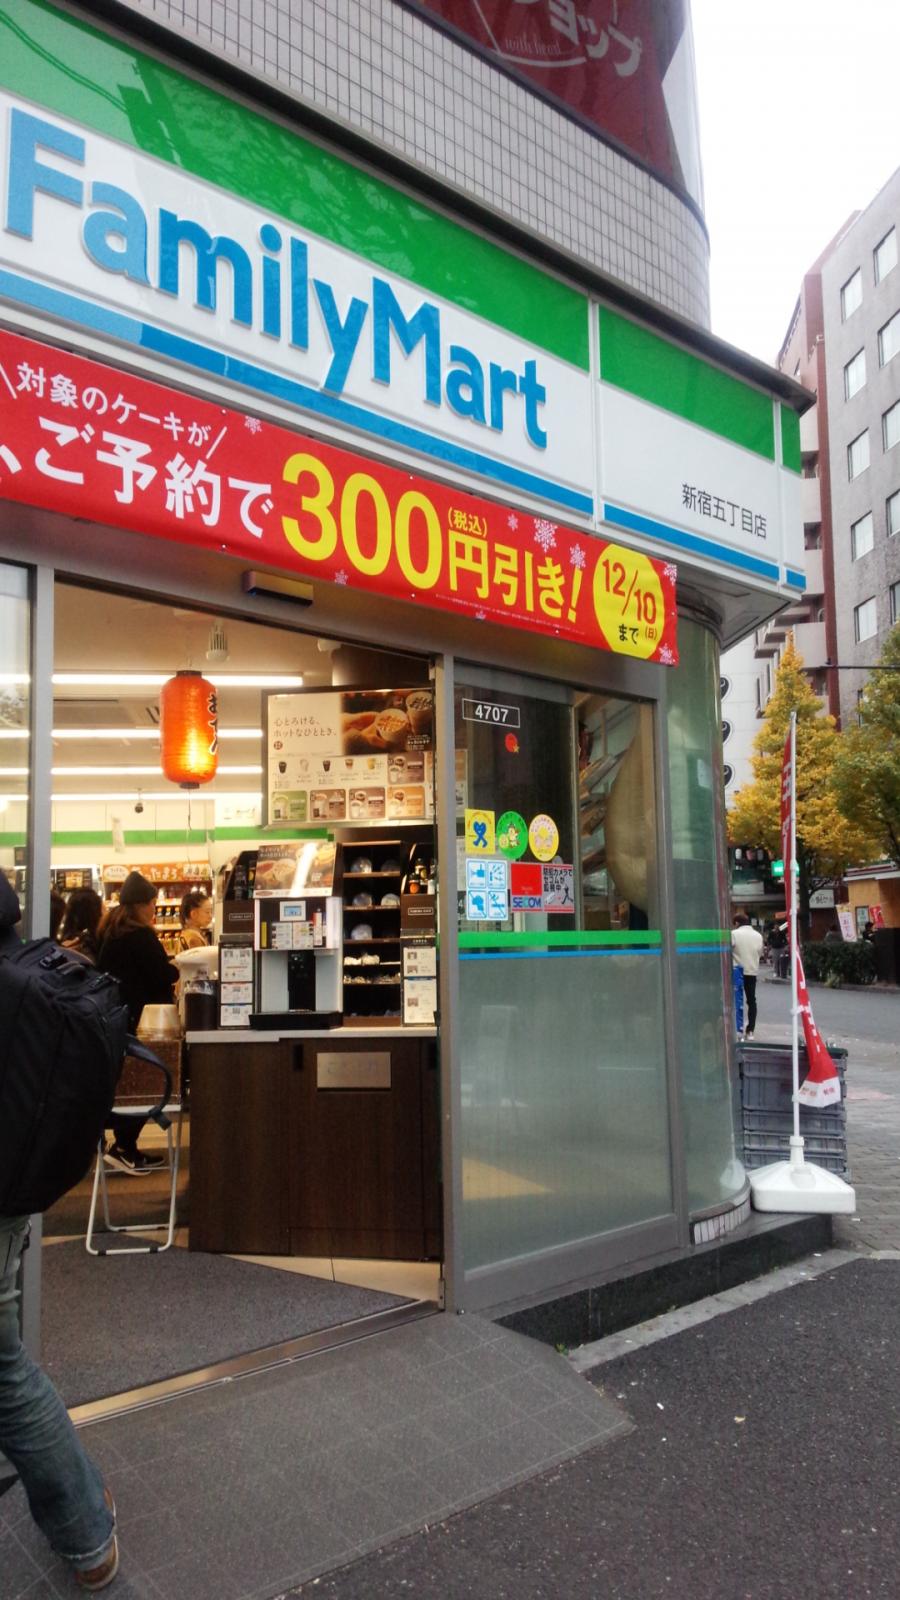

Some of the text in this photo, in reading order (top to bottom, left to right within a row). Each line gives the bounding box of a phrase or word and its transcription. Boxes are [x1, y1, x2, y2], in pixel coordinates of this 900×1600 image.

[3, 106, 548, 450] FamilyMart
[16, 361, 213, 448] 対象のケーキが
[448, 506, 489, 537] (税込)
[682, 483, 767, 539] 新宿五丁目店
[602, 558, 657, 625] 12/10
[618, 624, 639, 645] まで
[474, 704, 509, 723] 4707
[512, 896, 542, 908] SECOM
